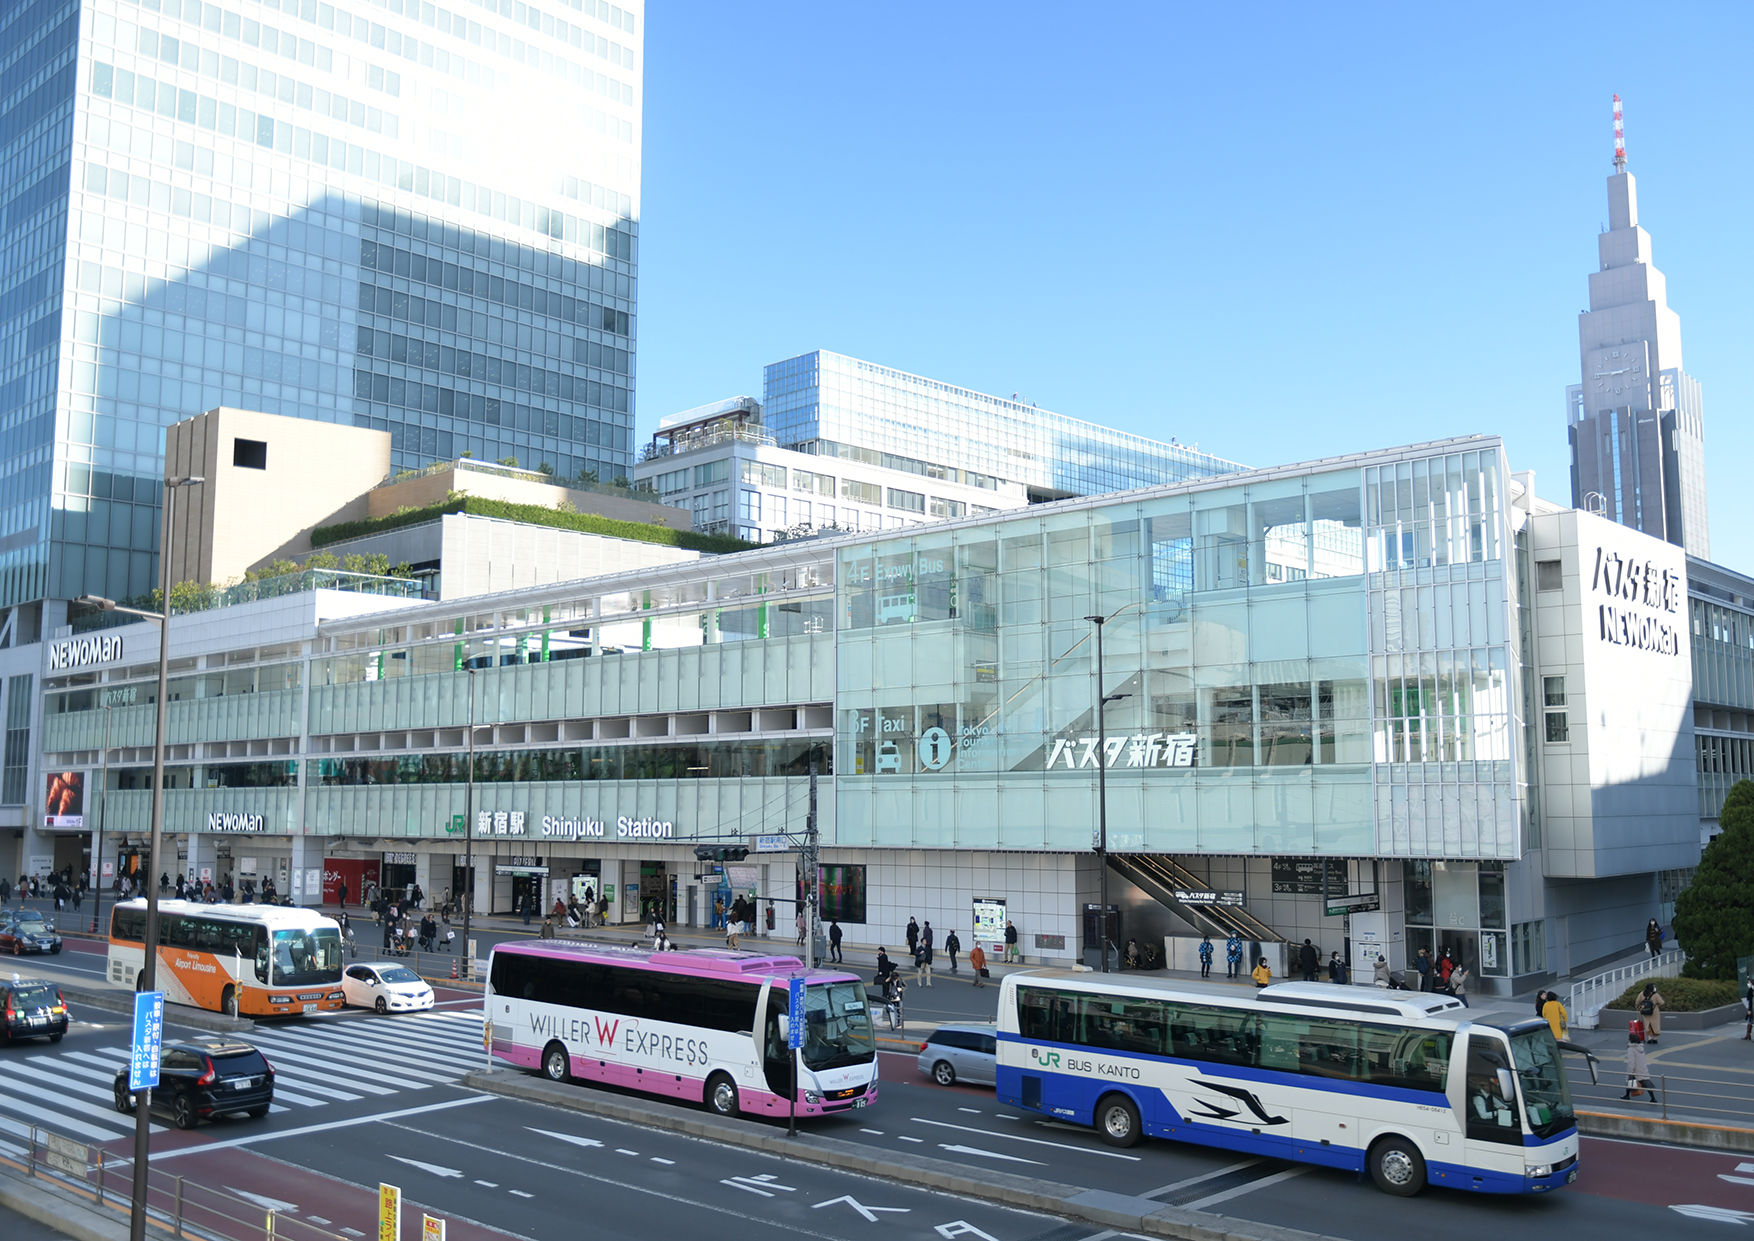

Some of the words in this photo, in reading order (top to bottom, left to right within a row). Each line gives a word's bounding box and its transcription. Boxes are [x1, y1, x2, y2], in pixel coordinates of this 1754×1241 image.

[876, 562, 914, 583] Expwy
[920, 557, 944, 575] Bus
[106, 686, 137, 704] バスタ新宿
[877, 715, 905, 733] Taxi
[958, 725, 989, 739] Tokyo
[1046, 731, 1198, 770] バスタ新宿
[958, 758, 993, 770] Center
[445, 815, 465, 833] JR
[478, 811, 525, 835] 新宿駅
[541, 815, 605, 841] Shinjuku
[617, 816, 674, 838] Station
[175, 958, 191, 970] Airport
[192, 961, 217, 973] Limousine
[142, 1012, 153, 1069] バスタ新宿へは
[530, 1012, 591, 1044] WILLER
[595, 1015, 619, 1048] W
[625, 1028, 708, 1066] EXPRESS
[133, 1045, 143, 1086] 入れません
[1039, 1052, 1060, 1068] JR
[1067, 1059, 1092, 1072] BUS
[1098, 1063, 1140, 1079] KANTO
